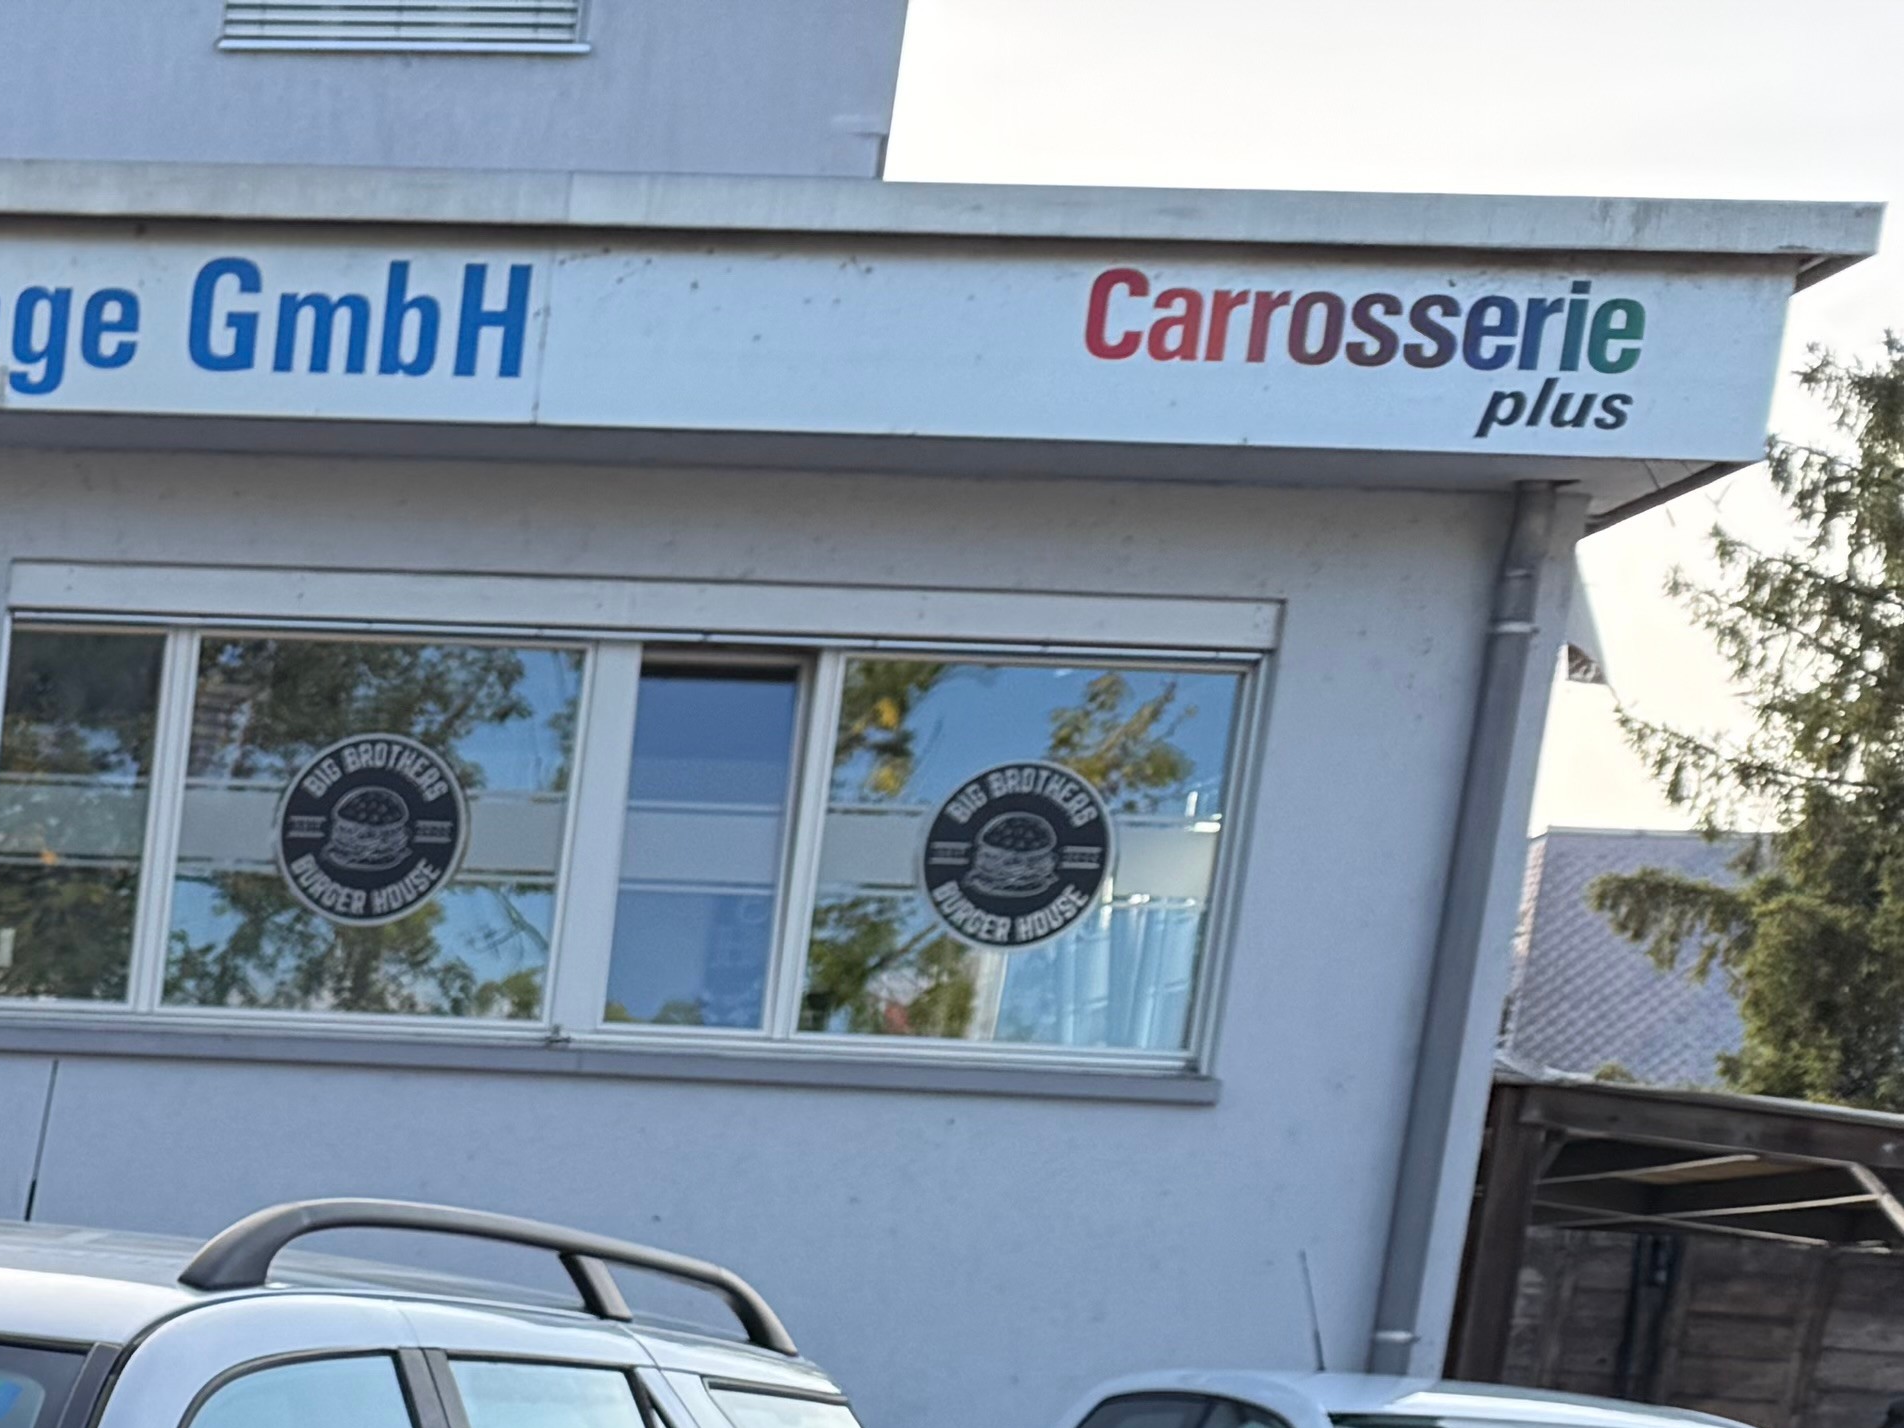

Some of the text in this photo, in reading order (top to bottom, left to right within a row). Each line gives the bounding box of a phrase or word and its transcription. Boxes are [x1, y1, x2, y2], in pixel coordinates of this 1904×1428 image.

[188, 256, 534, 379] GmbH
[1084, 267, 1646, 374] Carrosserie
[1473, 377, 1634, 438] plus
[302, 742, 449, 802] BIG BROTHERS
[945, 767, 1099, 828] BIG BROTHERS
[291, 853, 442, 914] BURGER HOUSE
[932, 880, 1089, 942] BURGER HOUSE
